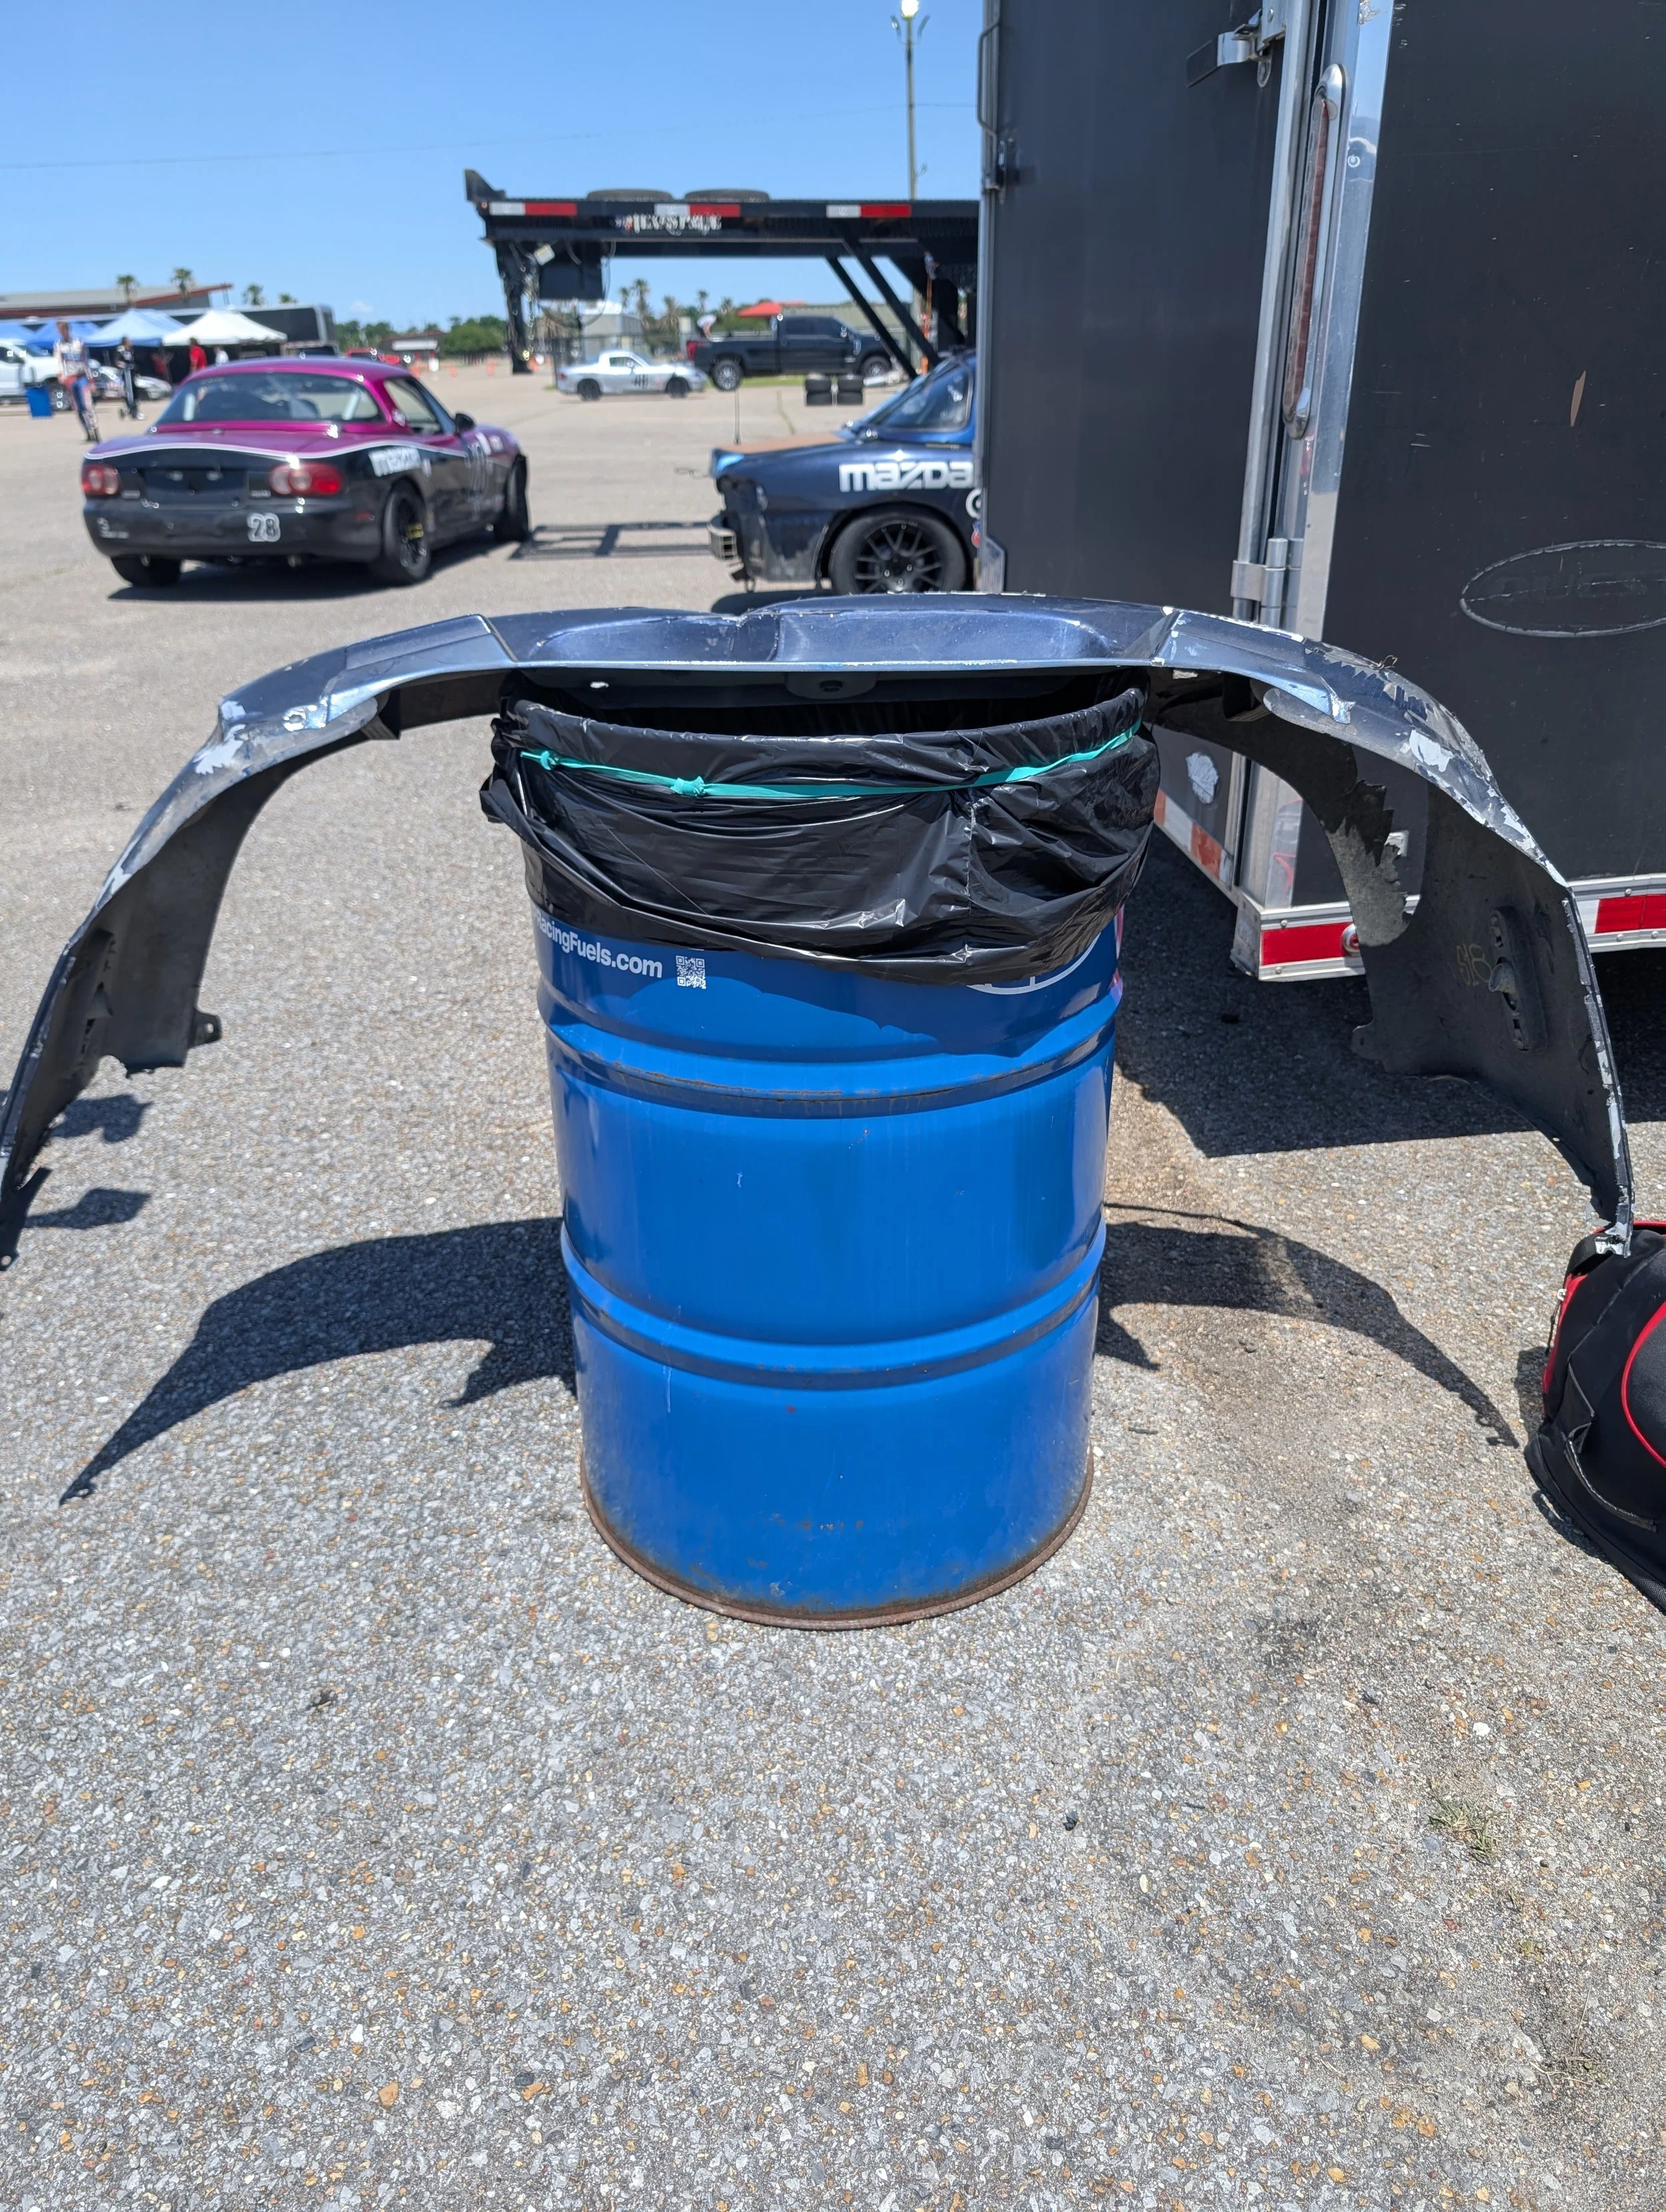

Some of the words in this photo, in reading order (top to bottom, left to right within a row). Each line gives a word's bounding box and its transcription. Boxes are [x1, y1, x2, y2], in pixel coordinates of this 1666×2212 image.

[839, 461, 974, 492] mazda
[247, 512, 281, 543] 28
[534, 907, 662, 979] RacingFuels.com
